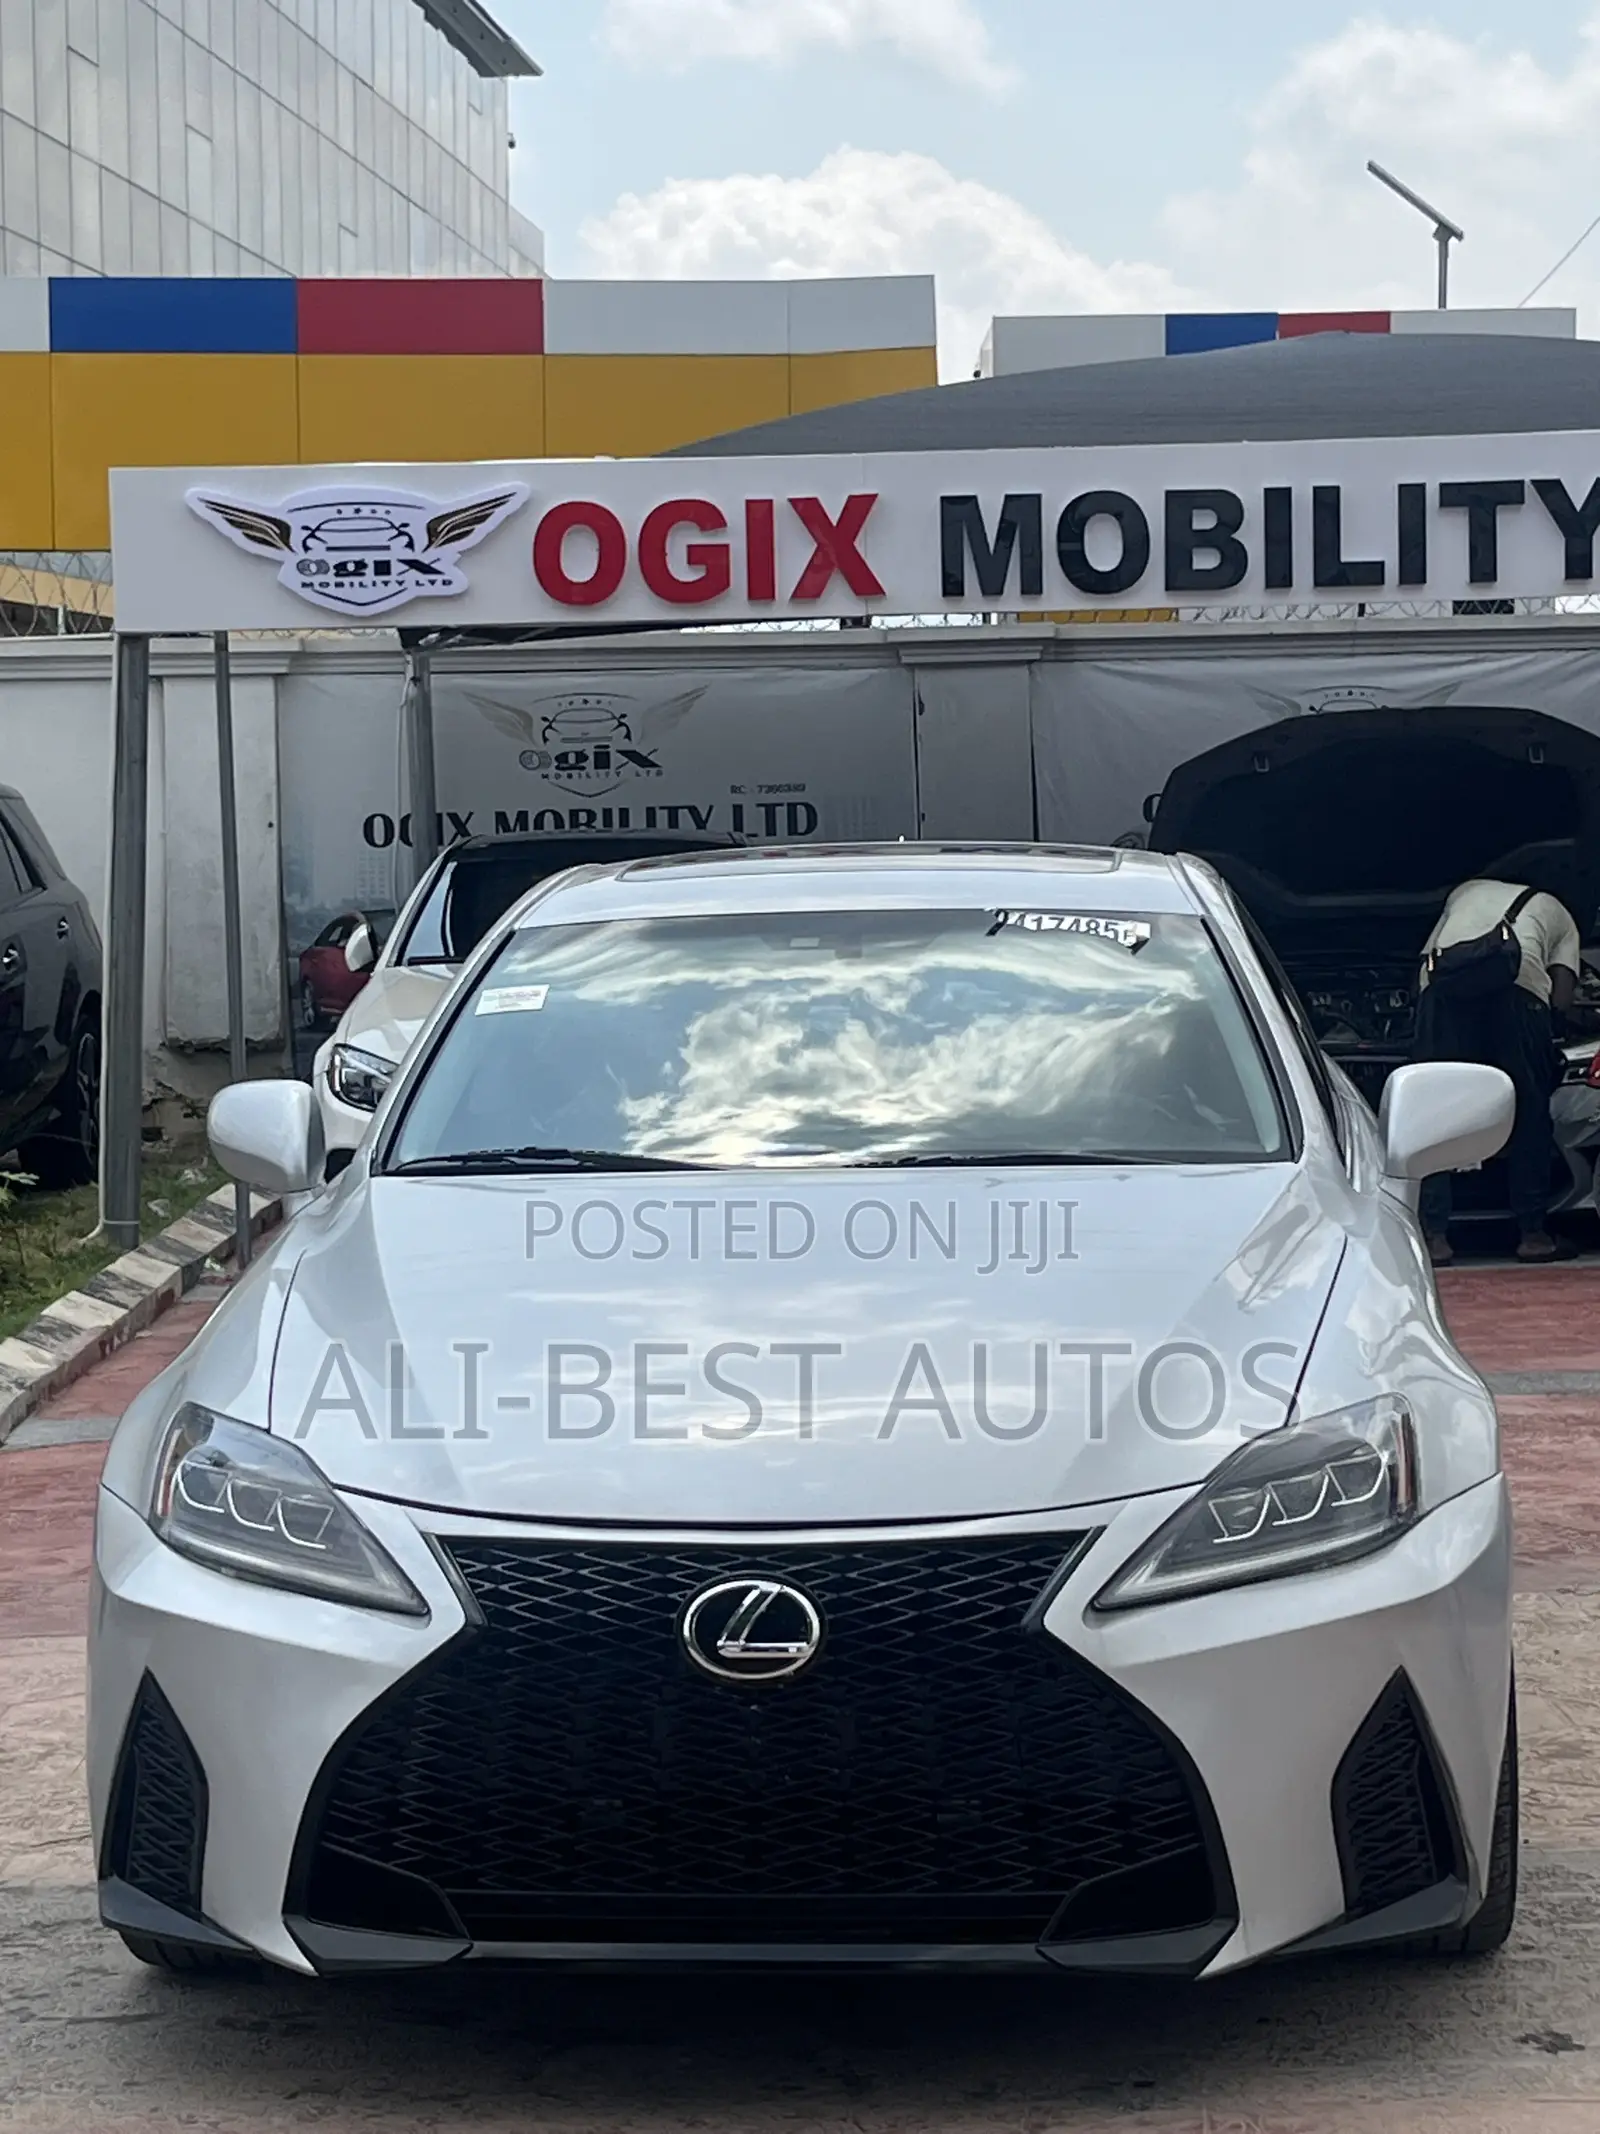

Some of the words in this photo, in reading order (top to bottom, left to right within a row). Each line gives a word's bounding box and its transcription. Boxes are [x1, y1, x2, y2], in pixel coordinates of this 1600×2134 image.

[533, 493, 886, 606] OGIX
[939, 477, 1600, 598] MOBILITY
[301, 579, 406, 589] MOBILITY
[415, 579, 454, 587] LTD
[732, 801, 818, 838] LTD
